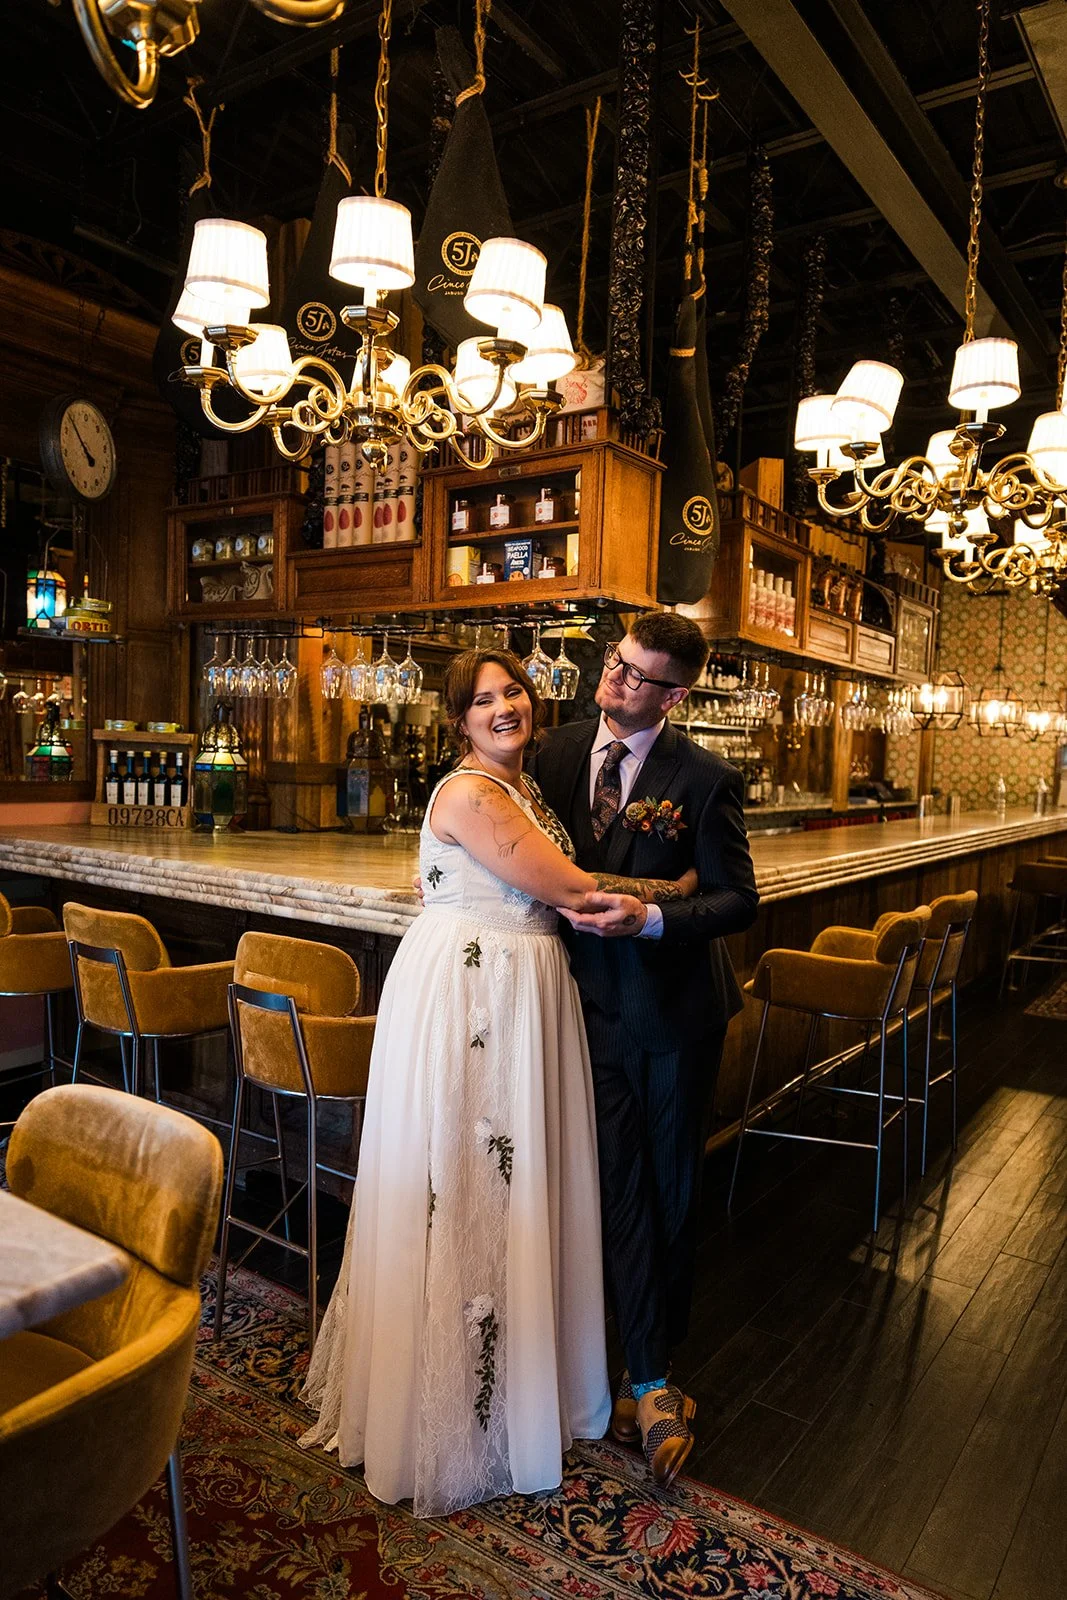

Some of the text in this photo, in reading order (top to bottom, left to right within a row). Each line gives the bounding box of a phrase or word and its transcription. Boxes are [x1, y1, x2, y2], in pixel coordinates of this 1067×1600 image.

[451, 241, 474, 267] 5J
[427, 274, 465, 291] Cinco
[305, 310, 327, 333] 5J
[691, 504, 708, 527] 5J
[669, 532, 701, 546] Cinco
[507, 551, 529, 559] PAELLA
[71, 621, 110, 631] ORTIZ
[108, 807, 185, 827] 09728CA
